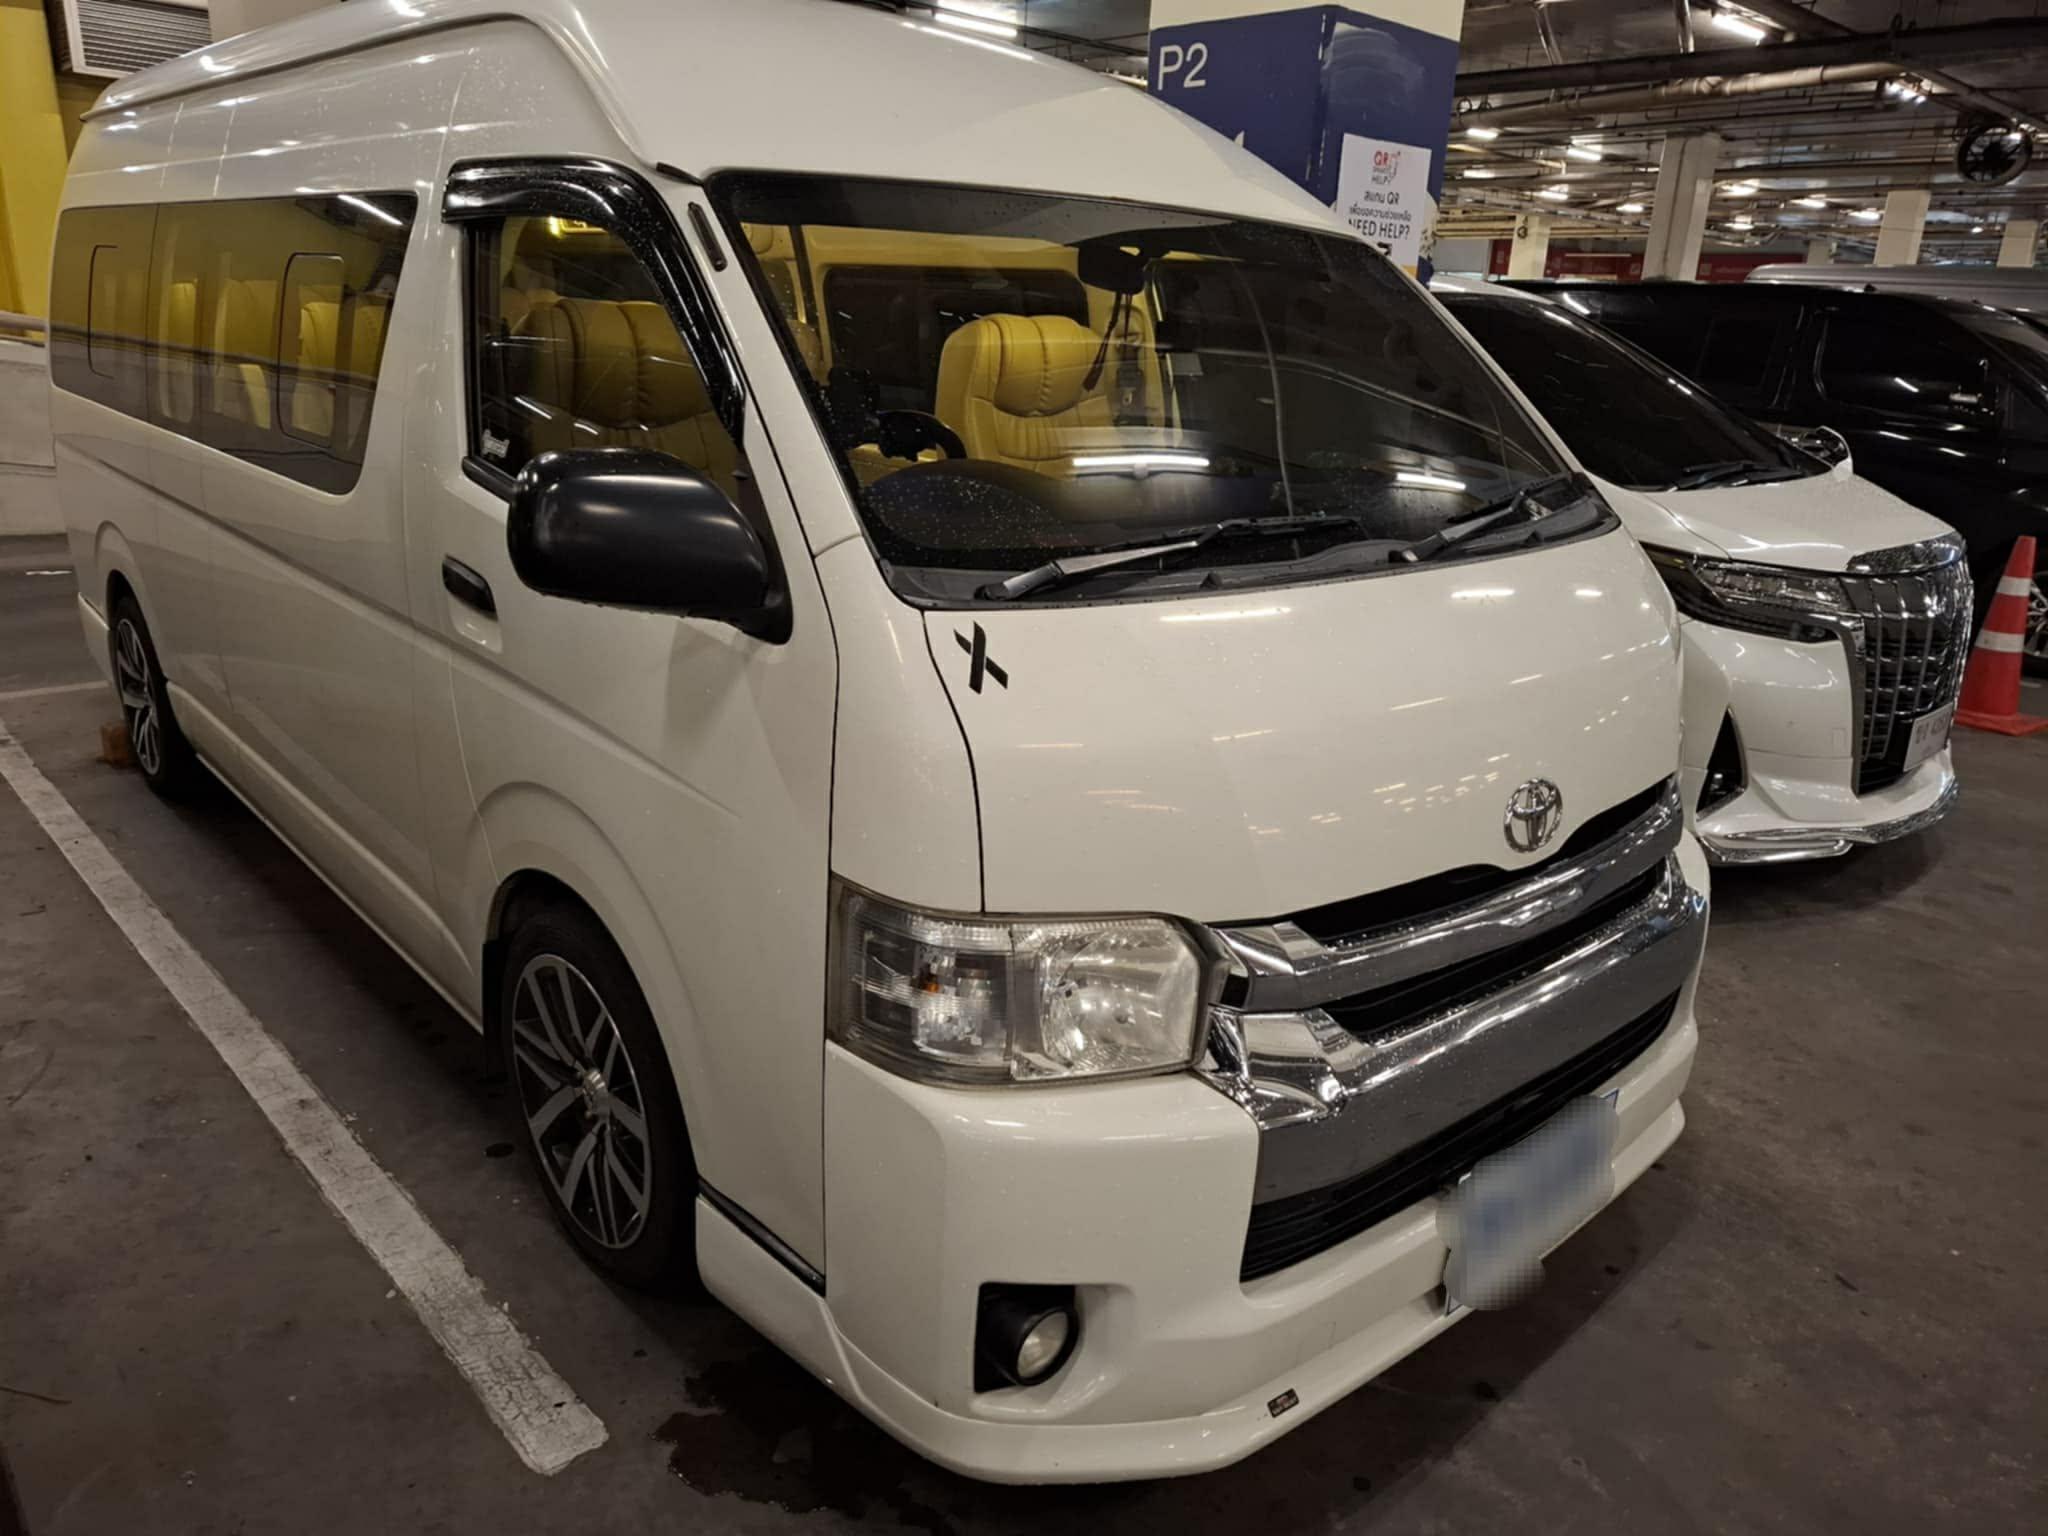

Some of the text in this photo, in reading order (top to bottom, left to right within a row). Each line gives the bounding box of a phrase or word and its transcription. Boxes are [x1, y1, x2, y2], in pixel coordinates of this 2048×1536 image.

[1156, 42, 1209, 91] P2
[1374, 150, 1389, 166] QR
[1387, 191, 1400, 205] QR
[1379, 222, 1410, 240] HELP?
